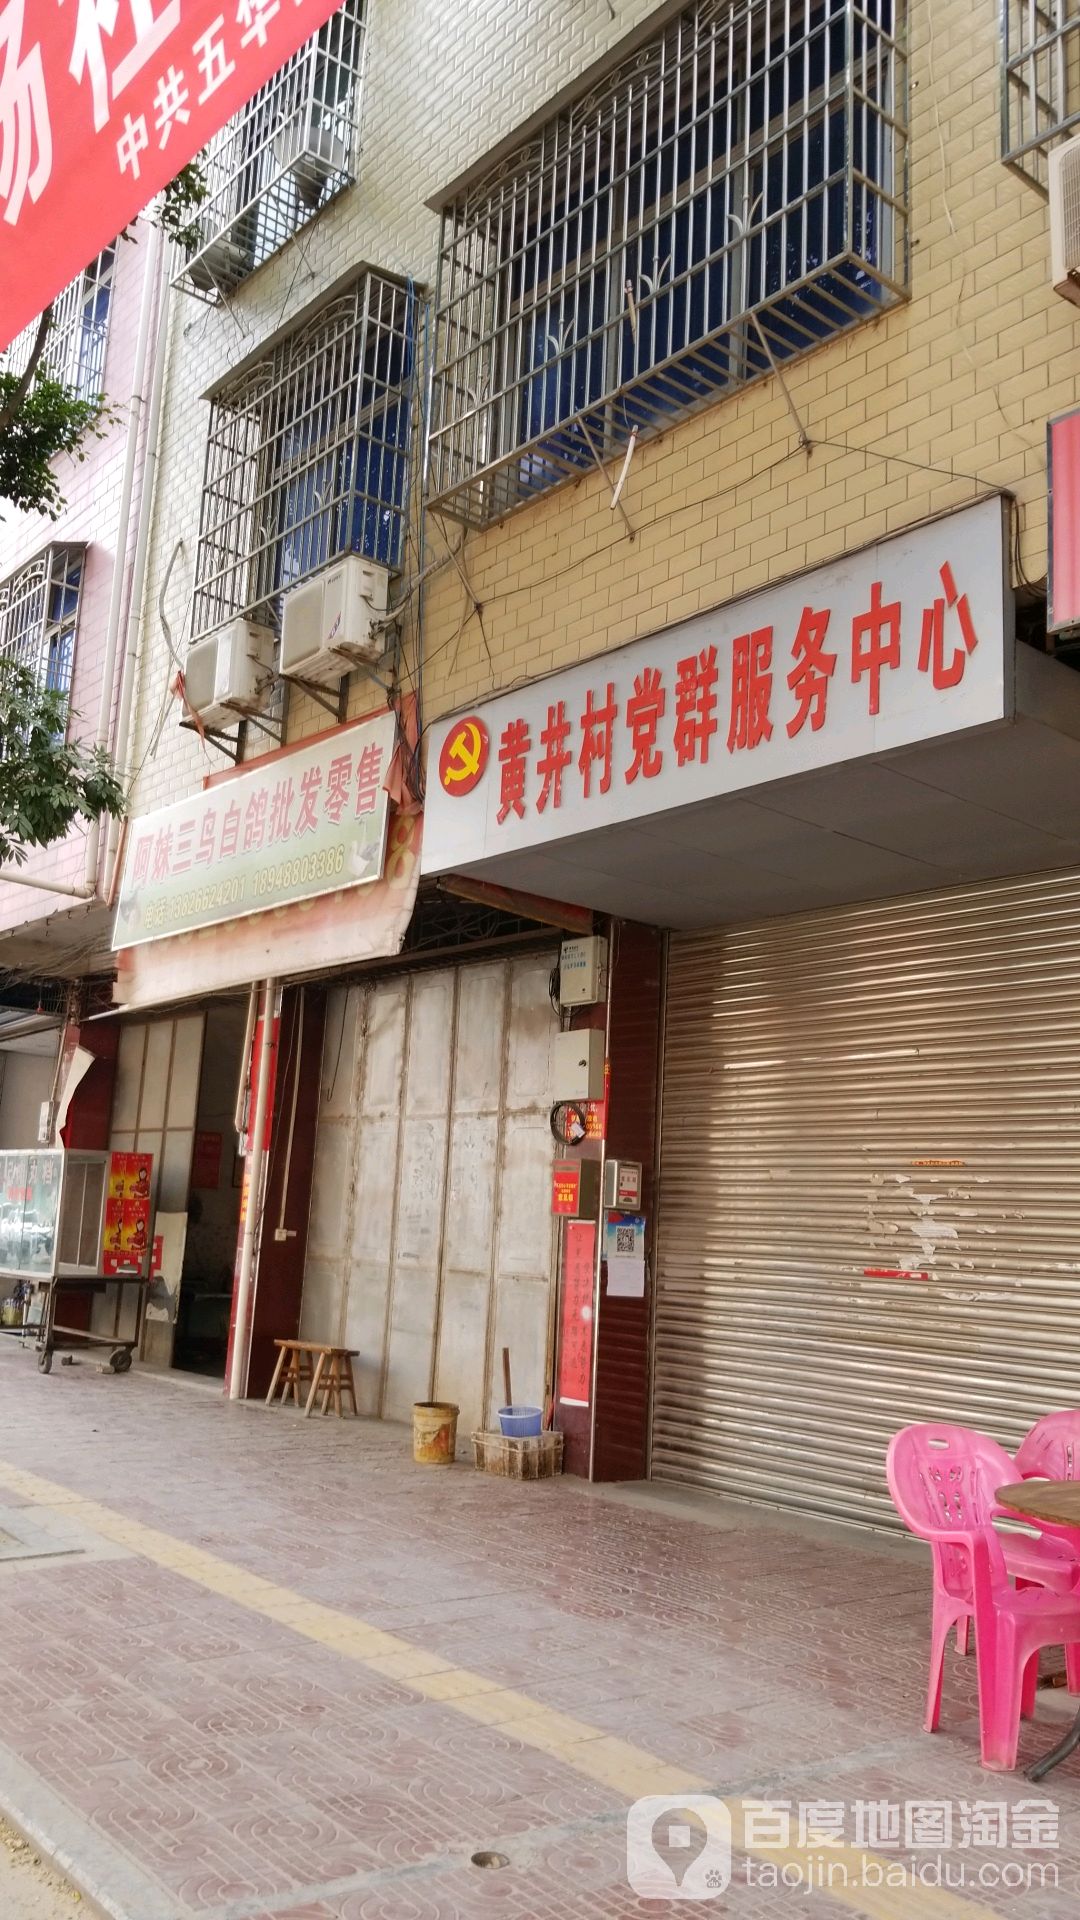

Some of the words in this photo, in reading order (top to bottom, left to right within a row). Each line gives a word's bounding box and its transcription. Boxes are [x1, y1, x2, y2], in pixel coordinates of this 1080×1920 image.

[496, 560, 979, 826] 黄井村党群服务中心
[252, 844, 345, 897] 18948803386
